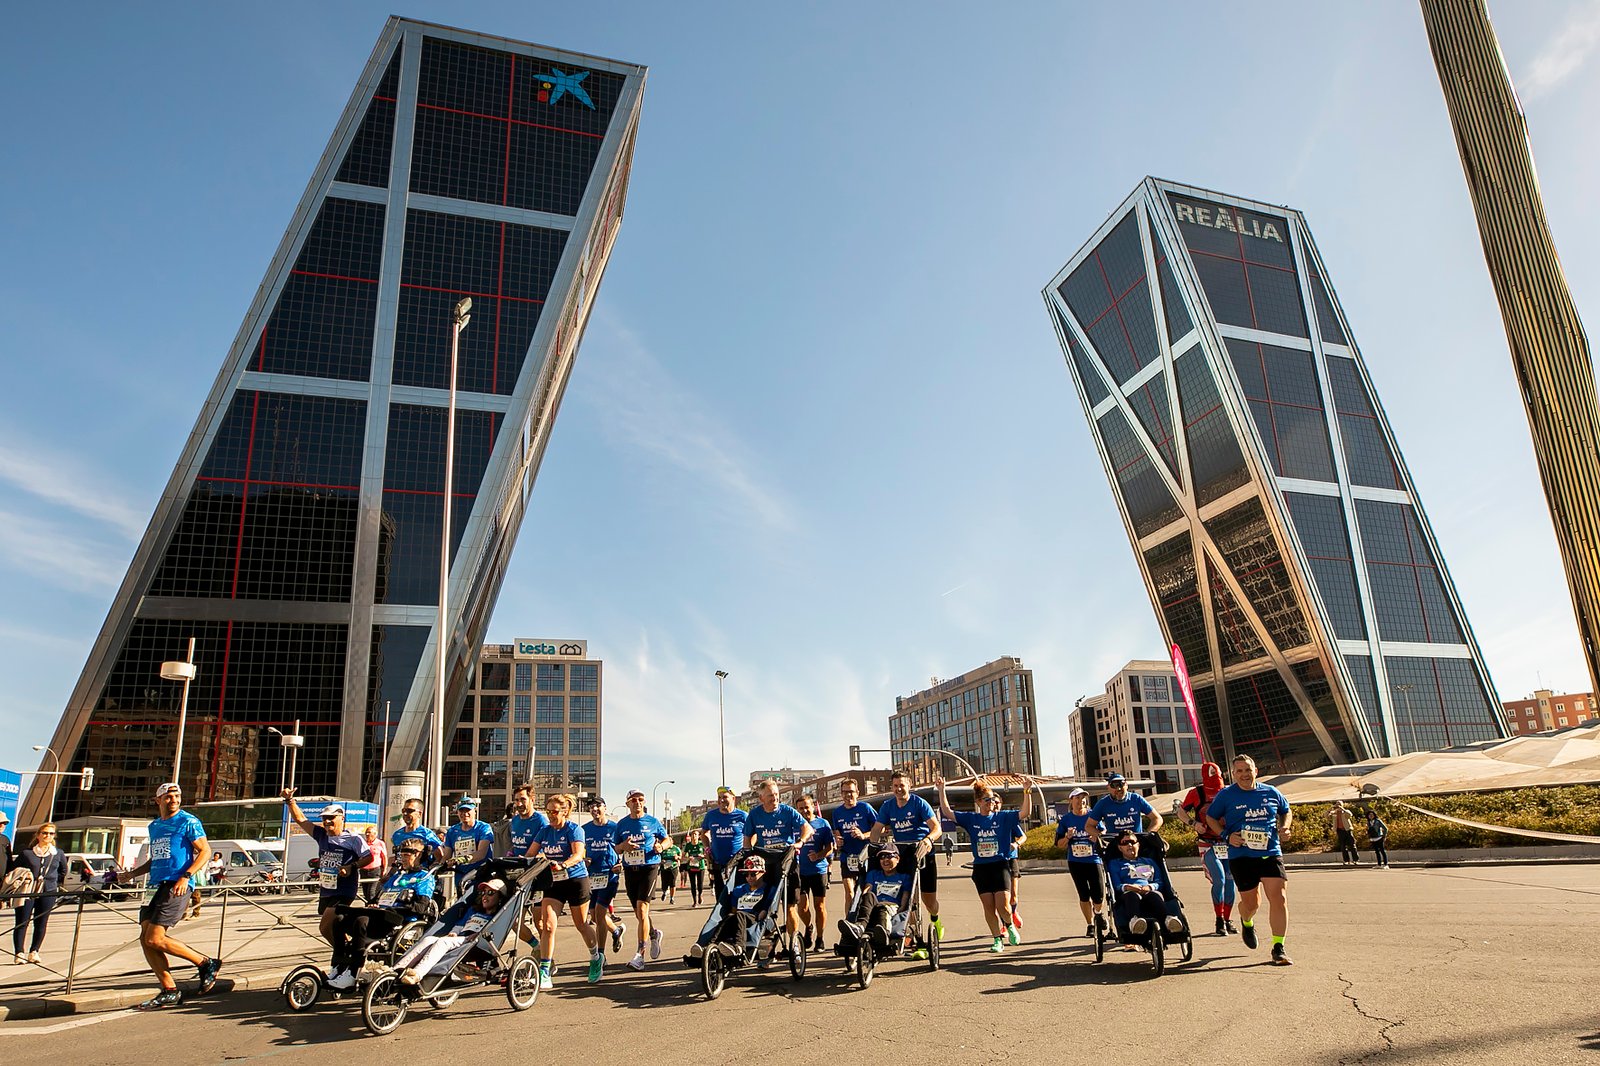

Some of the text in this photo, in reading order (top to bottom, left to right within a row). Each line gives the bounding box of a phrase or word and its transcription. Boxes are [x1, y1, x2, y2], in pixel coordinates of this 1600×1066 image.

[1175, 202, 1283, 243] REALIA
[519, 642, 556, 655] testa
[1247, 832, 1262, 840] 9198
